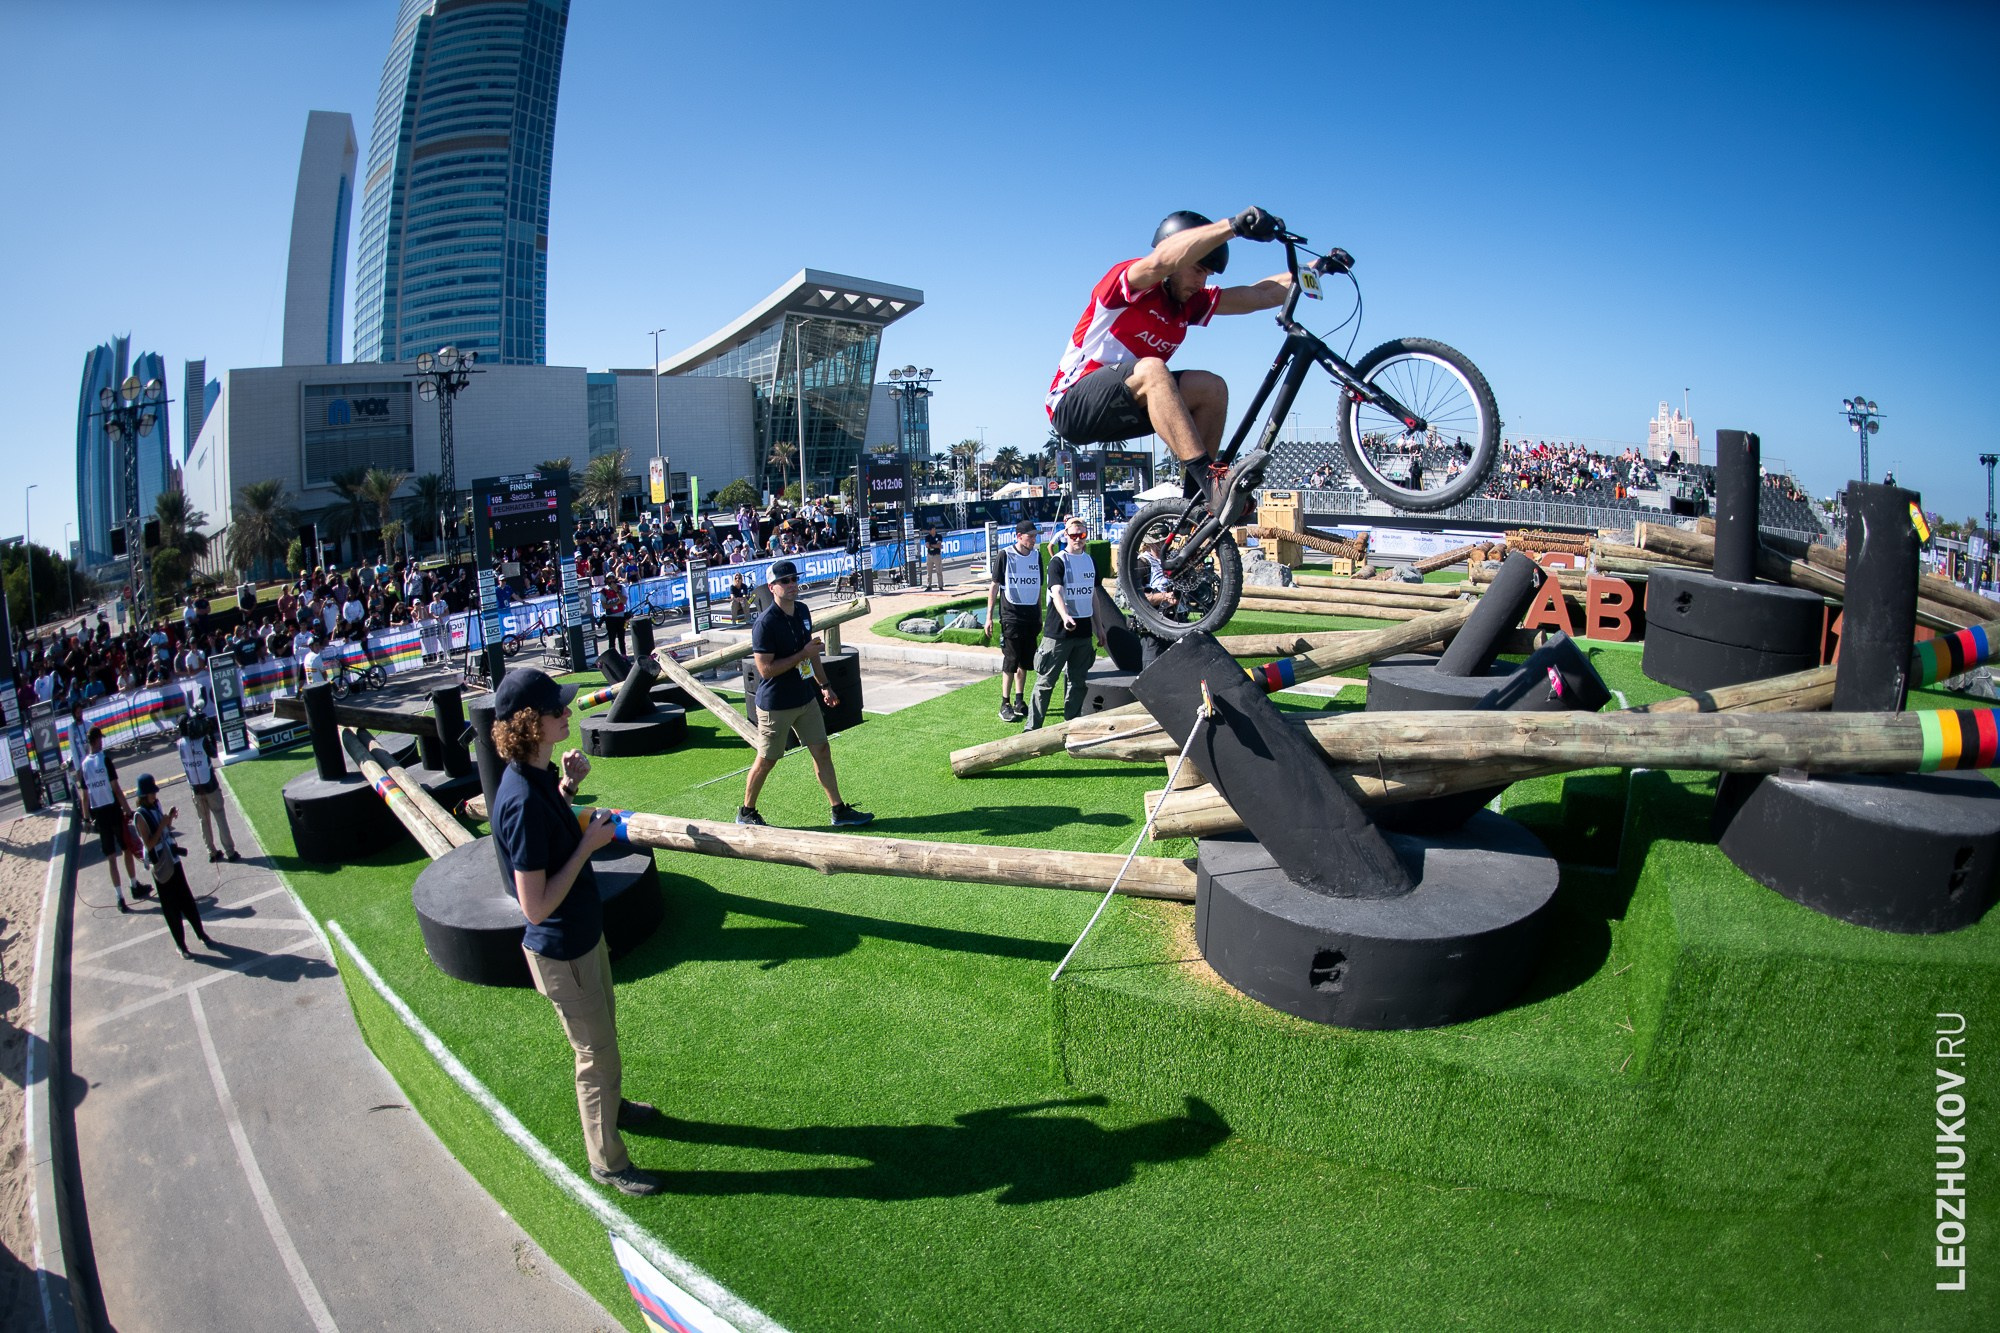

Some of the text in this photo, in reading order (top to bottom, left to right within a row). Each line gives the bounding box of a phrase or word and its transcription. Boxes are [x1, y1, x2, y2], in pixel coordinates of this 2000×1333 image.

[353, 398, 390, 416] VOX
[509, 482, 533, 491] FINISH
[872, 478, 903, 490] 13:12:06
[493, 502, 535, 513] PECHHACKER
[548, 514, 557, 523] 10
[991, 534, 996, 545] 5
[805, 554, 855, 577] SHIMA
[691, 570, 707, 579] START
[695, 578, 705, 592] 4
[1009, 577, 1018, 585] TV
[578, 590, 591, 598] NISH
[1067, 587, 1076, 596] TV
[580, 598, 588, 614] 3
[1523, 573, 1634, 642] AB
[489, 627, 499, 635] UCI
[213, 669, 235, 680] START
[220, 679, 233, 698] 3
[40, 728, 53, 748] 2
[271, 730, 294, 743] UCI
[91, 781, 106, 789] HOST
